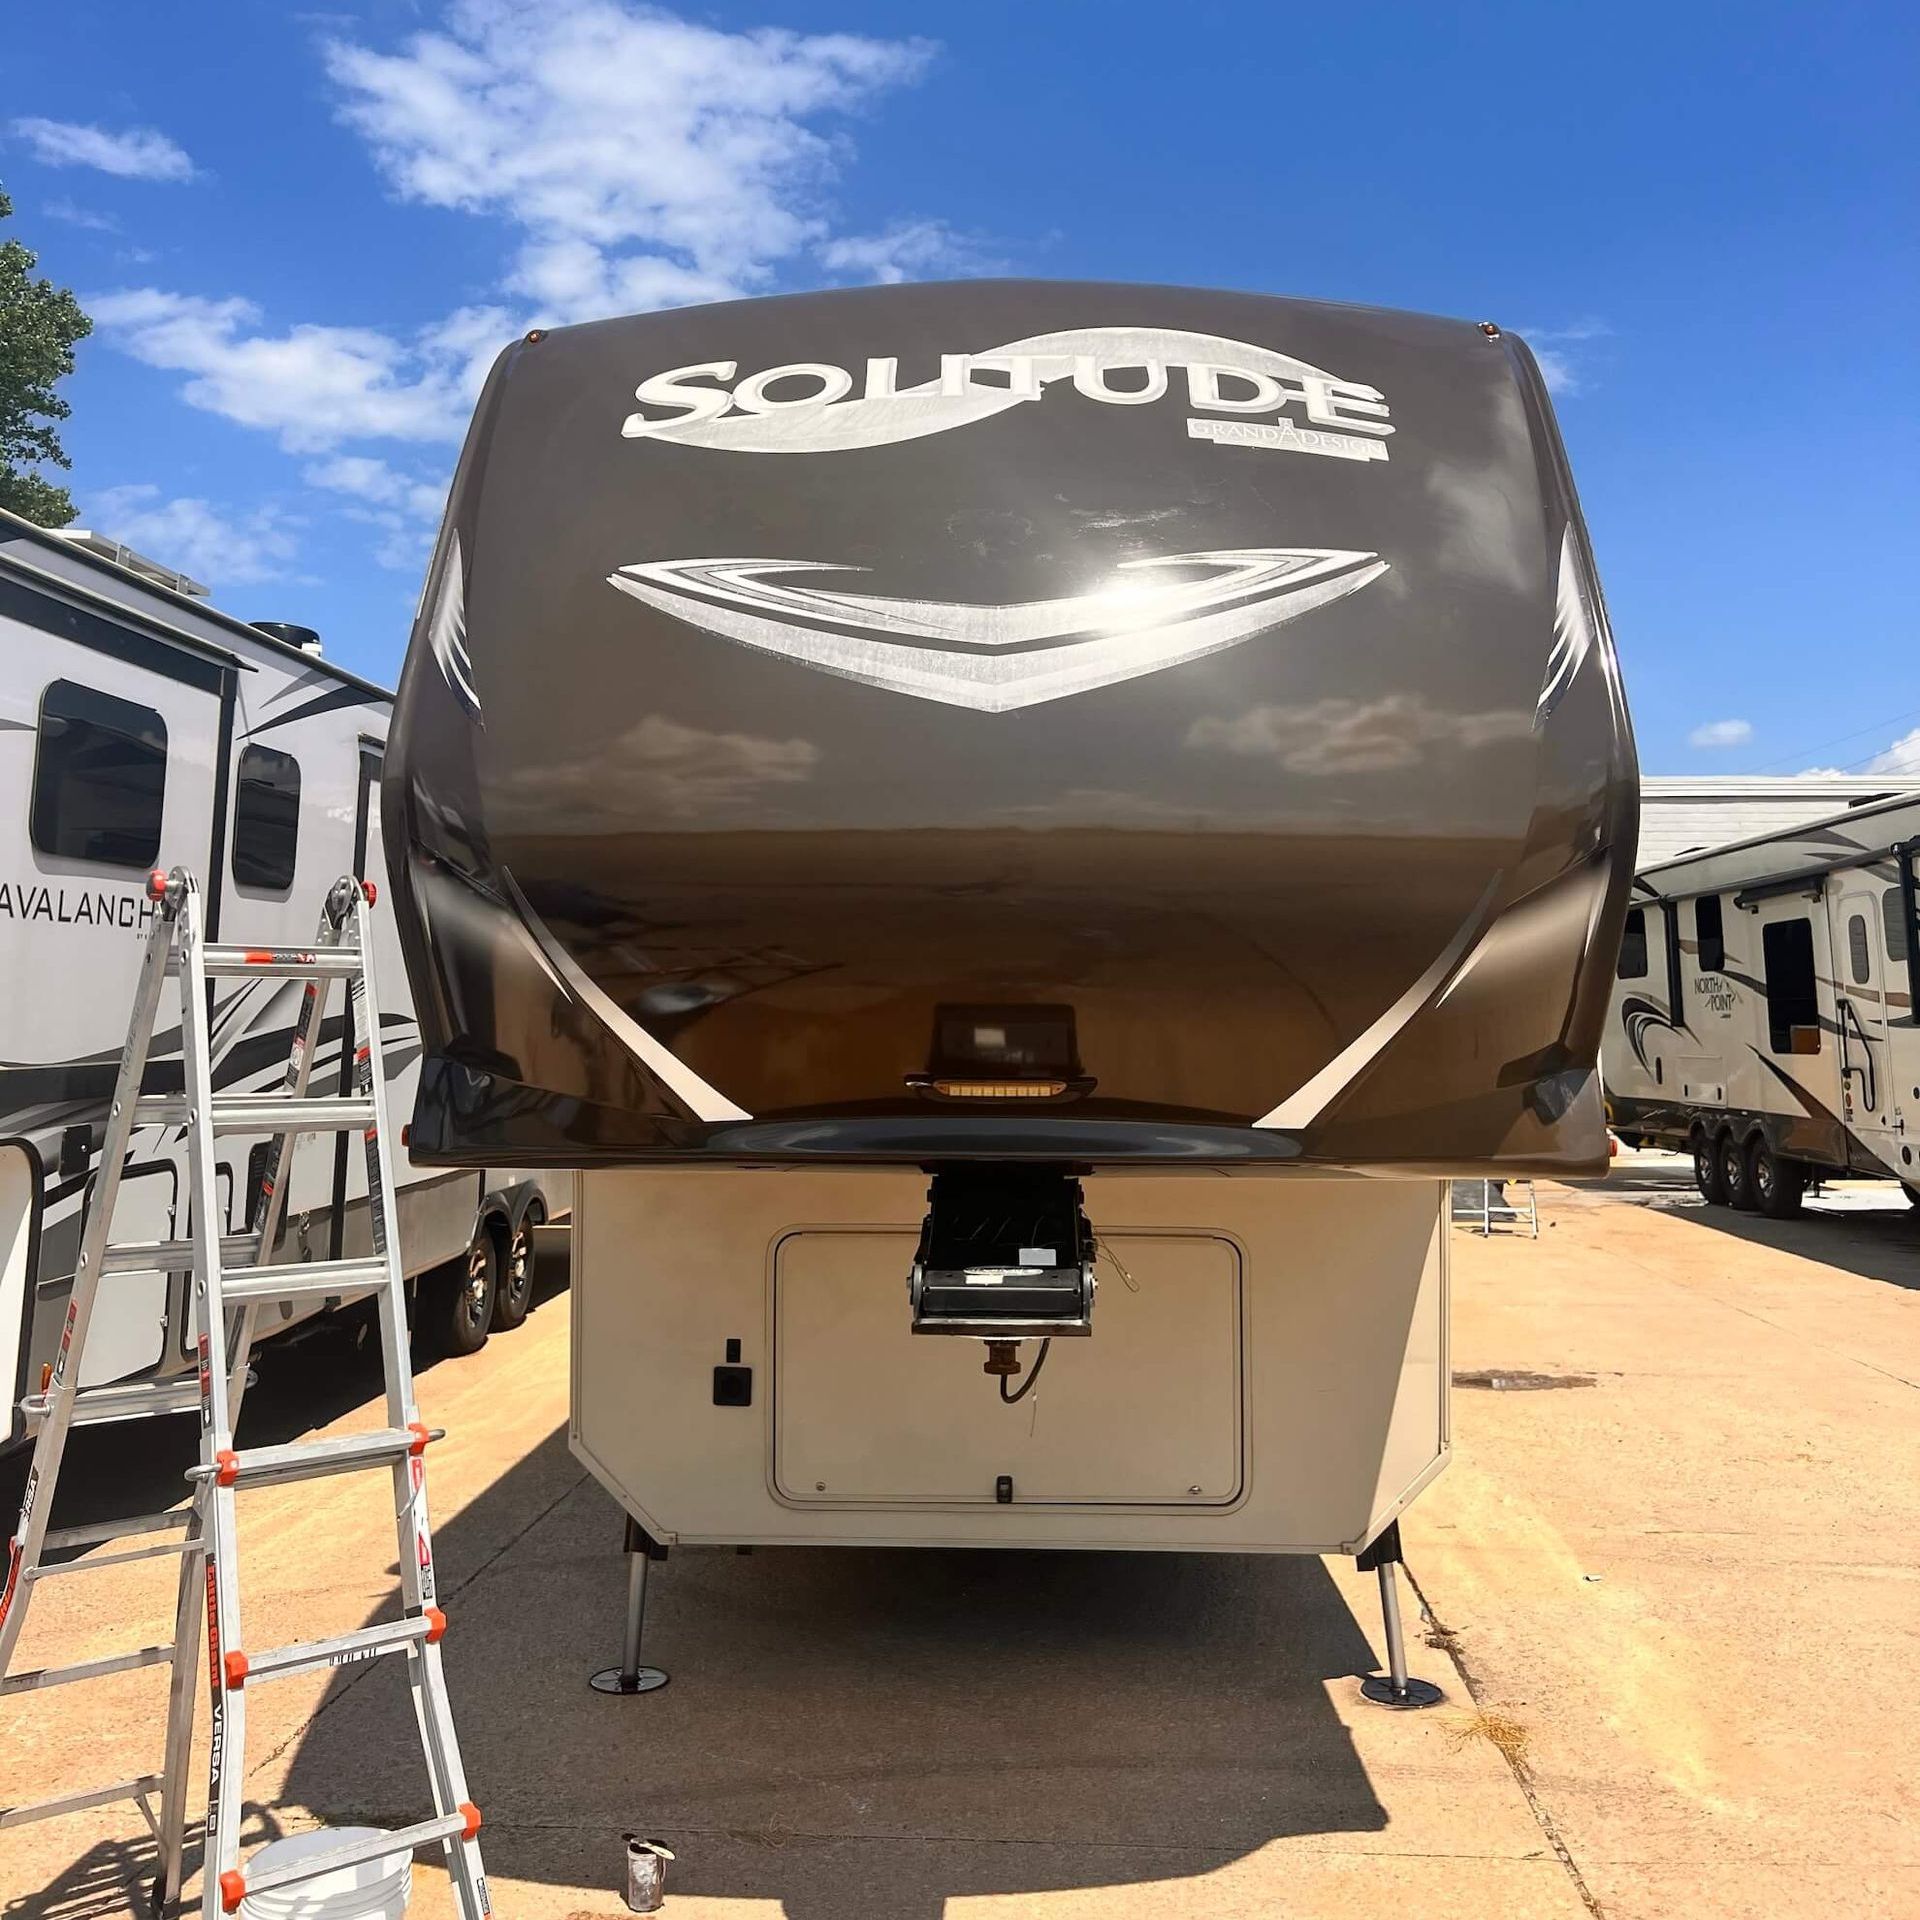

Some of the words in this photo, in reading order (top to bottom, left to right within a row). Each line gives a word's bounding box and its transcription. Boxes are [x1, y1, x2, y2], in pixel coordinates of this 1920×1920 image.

[621, 353, 1396, 437] SOLITUDE
[0, 883, 154, 929] AVALANCH
[1694, 977, 1719, 994] NORTH
[1710, 994, 1732, 1011] POINT
[211, 1703, 223, 1785] VERSA
